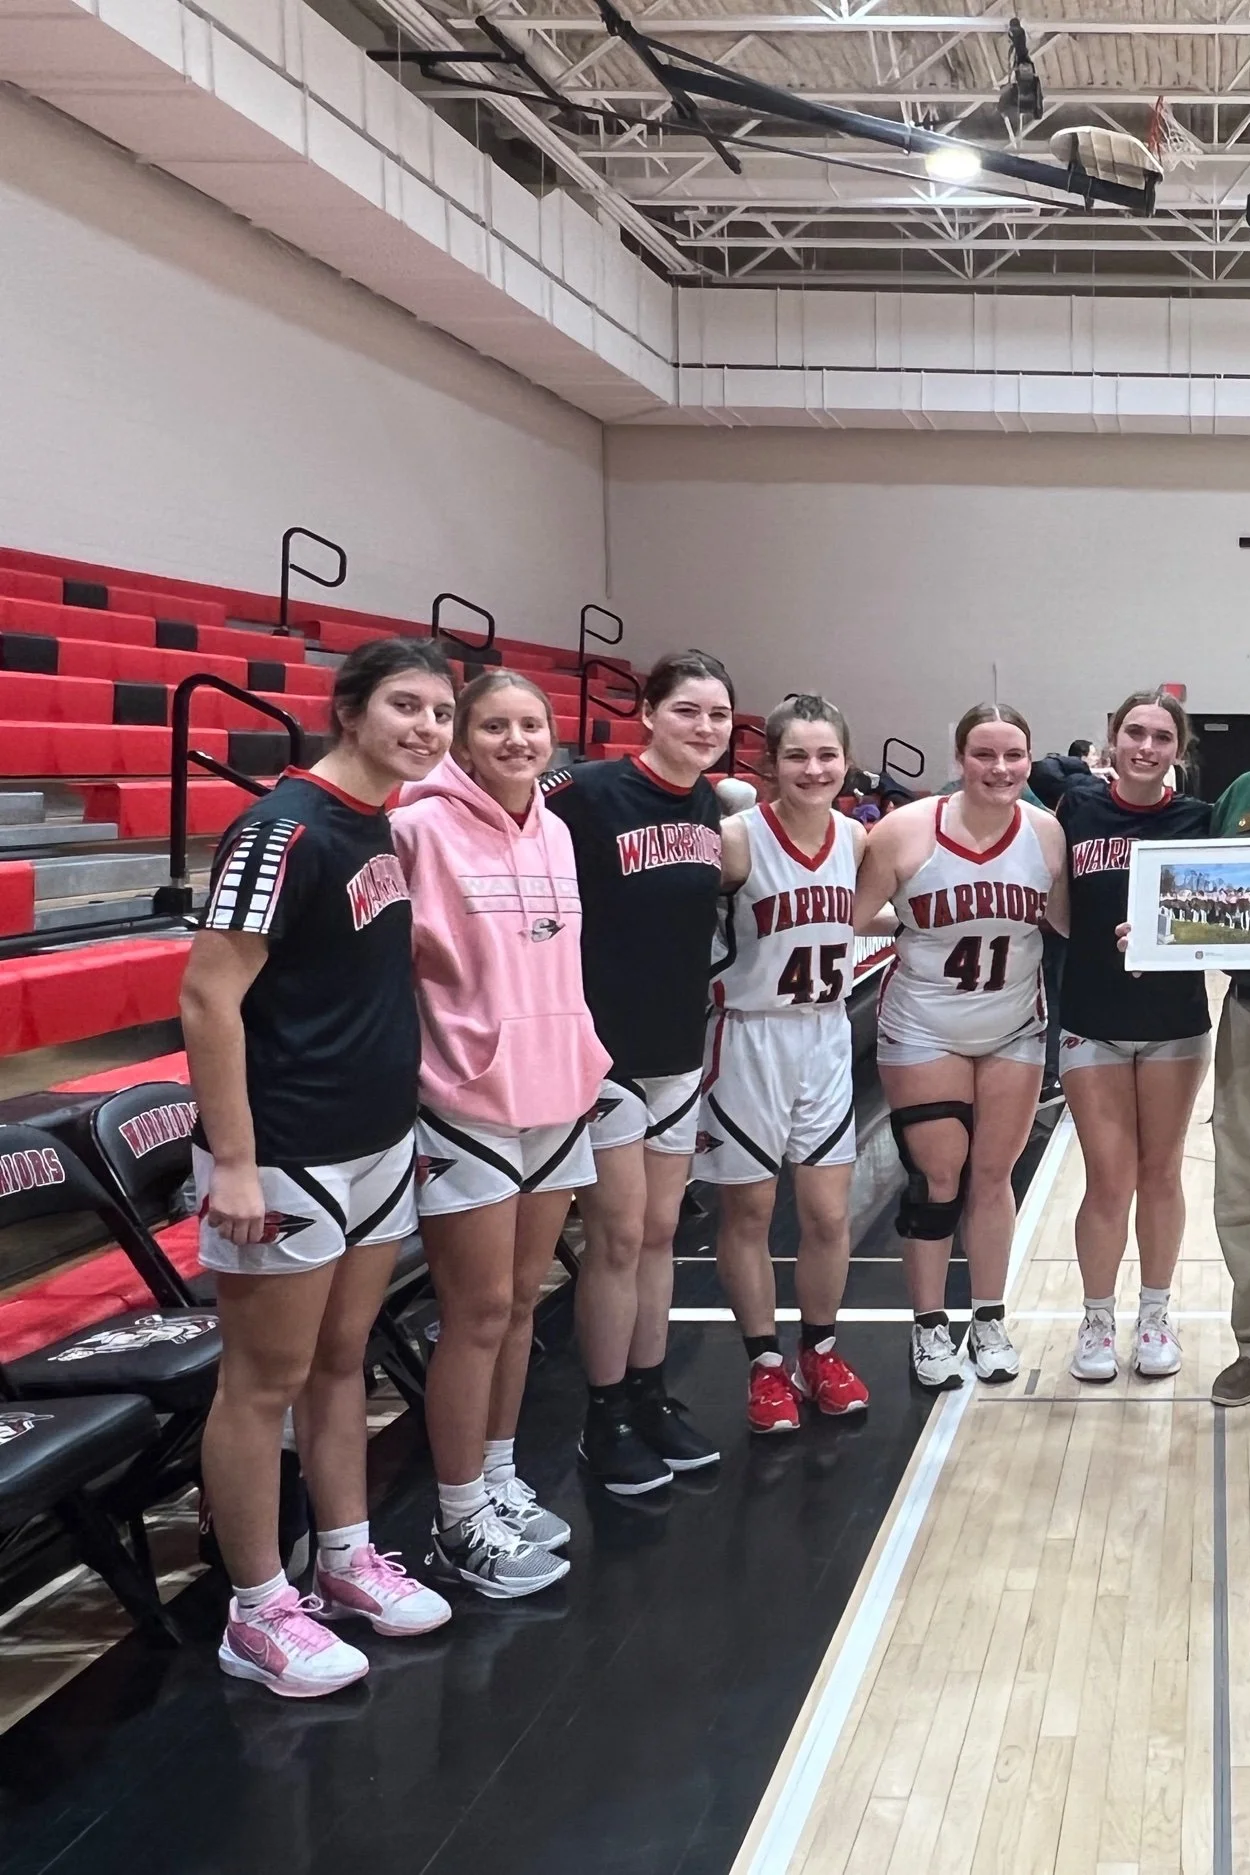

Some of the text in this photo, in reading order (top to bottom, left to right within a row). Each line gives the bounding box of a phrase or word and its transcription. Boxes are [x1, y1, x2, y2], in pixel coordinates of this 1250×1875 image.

[751, 885, 854, 940] WARRIO
[776, 942, 848, 1006] 45
[943, 935, 1011, 992] 41
